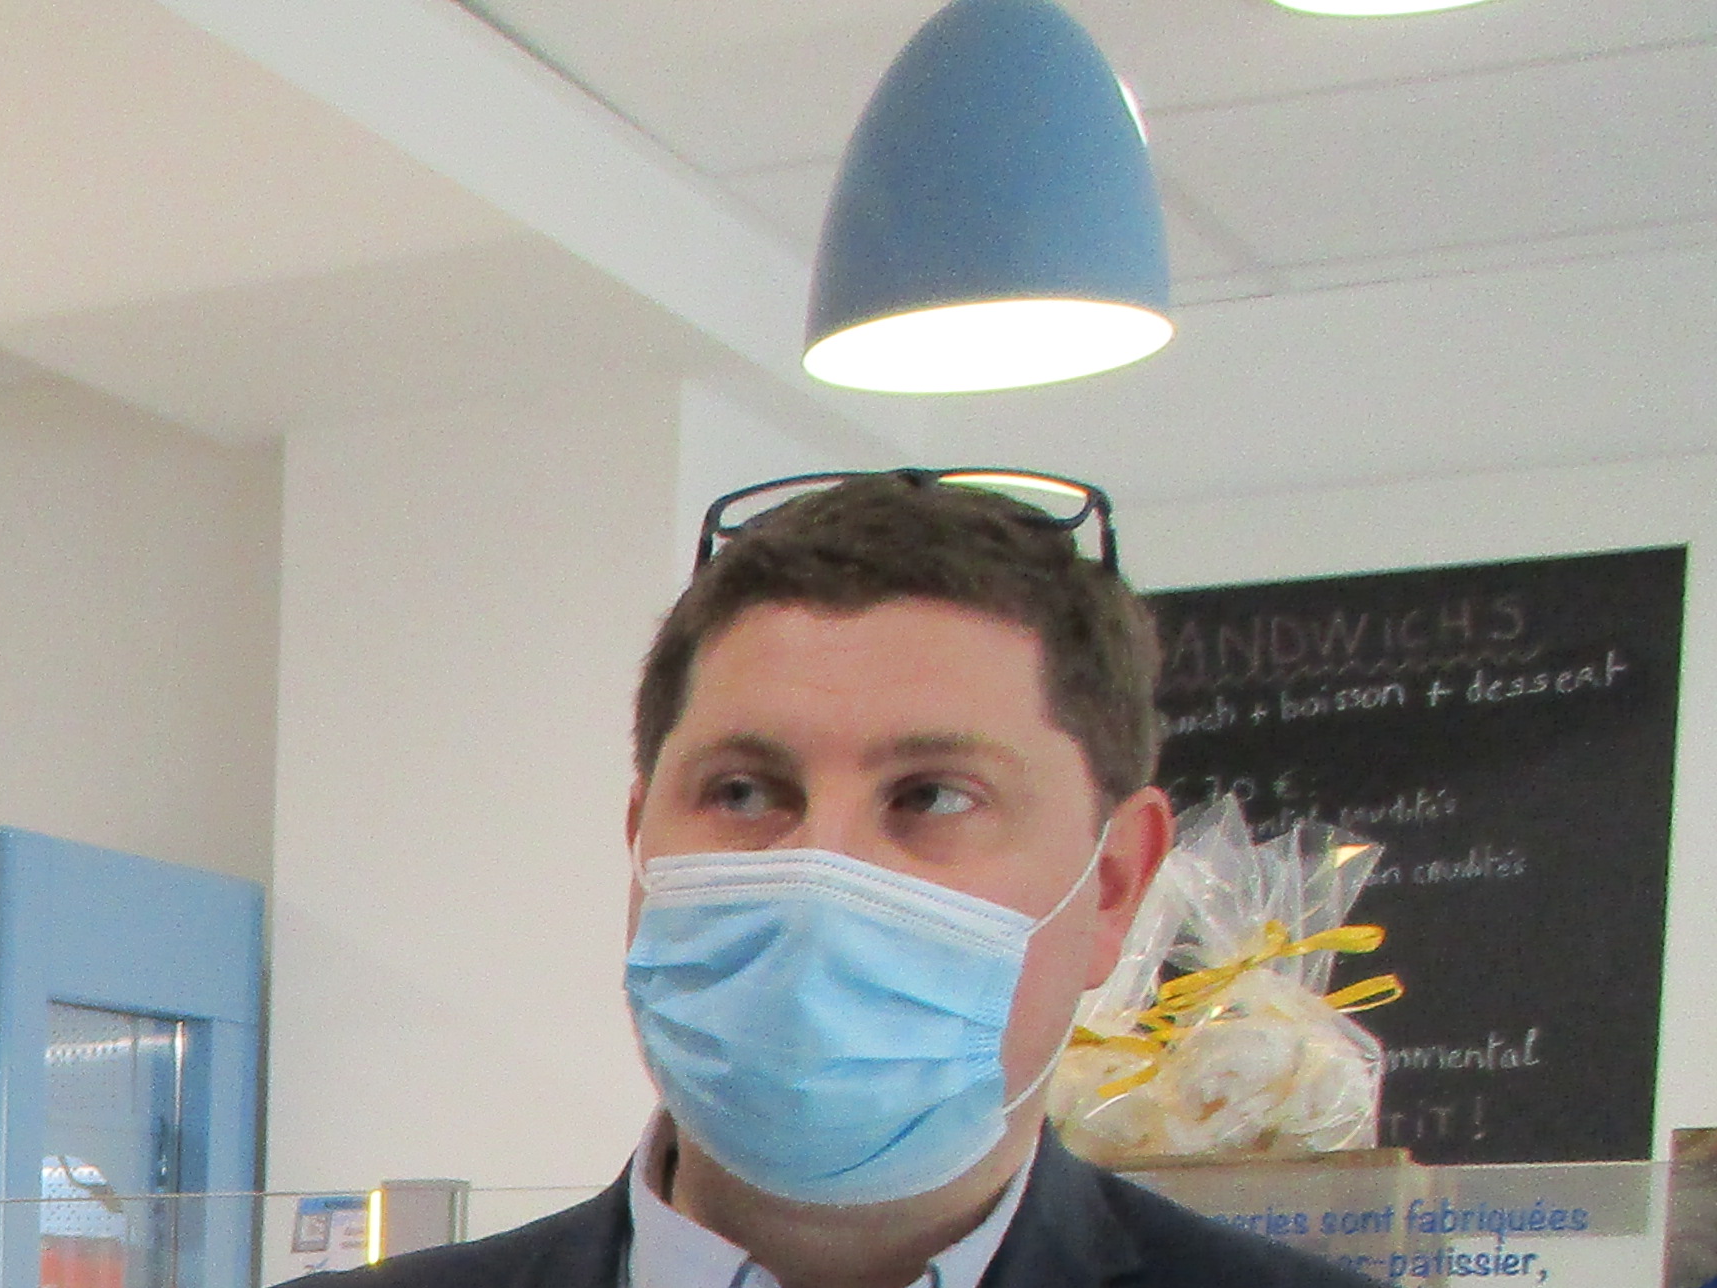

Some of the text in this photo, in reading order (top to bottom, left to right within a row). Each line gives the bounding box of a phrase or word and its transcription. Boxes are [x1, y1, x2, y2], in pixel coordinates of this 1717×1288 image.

[1168, 598, 1527, 680] ANDWICHS
[1320, 1199, 1589, 1242] sont fabriquées
